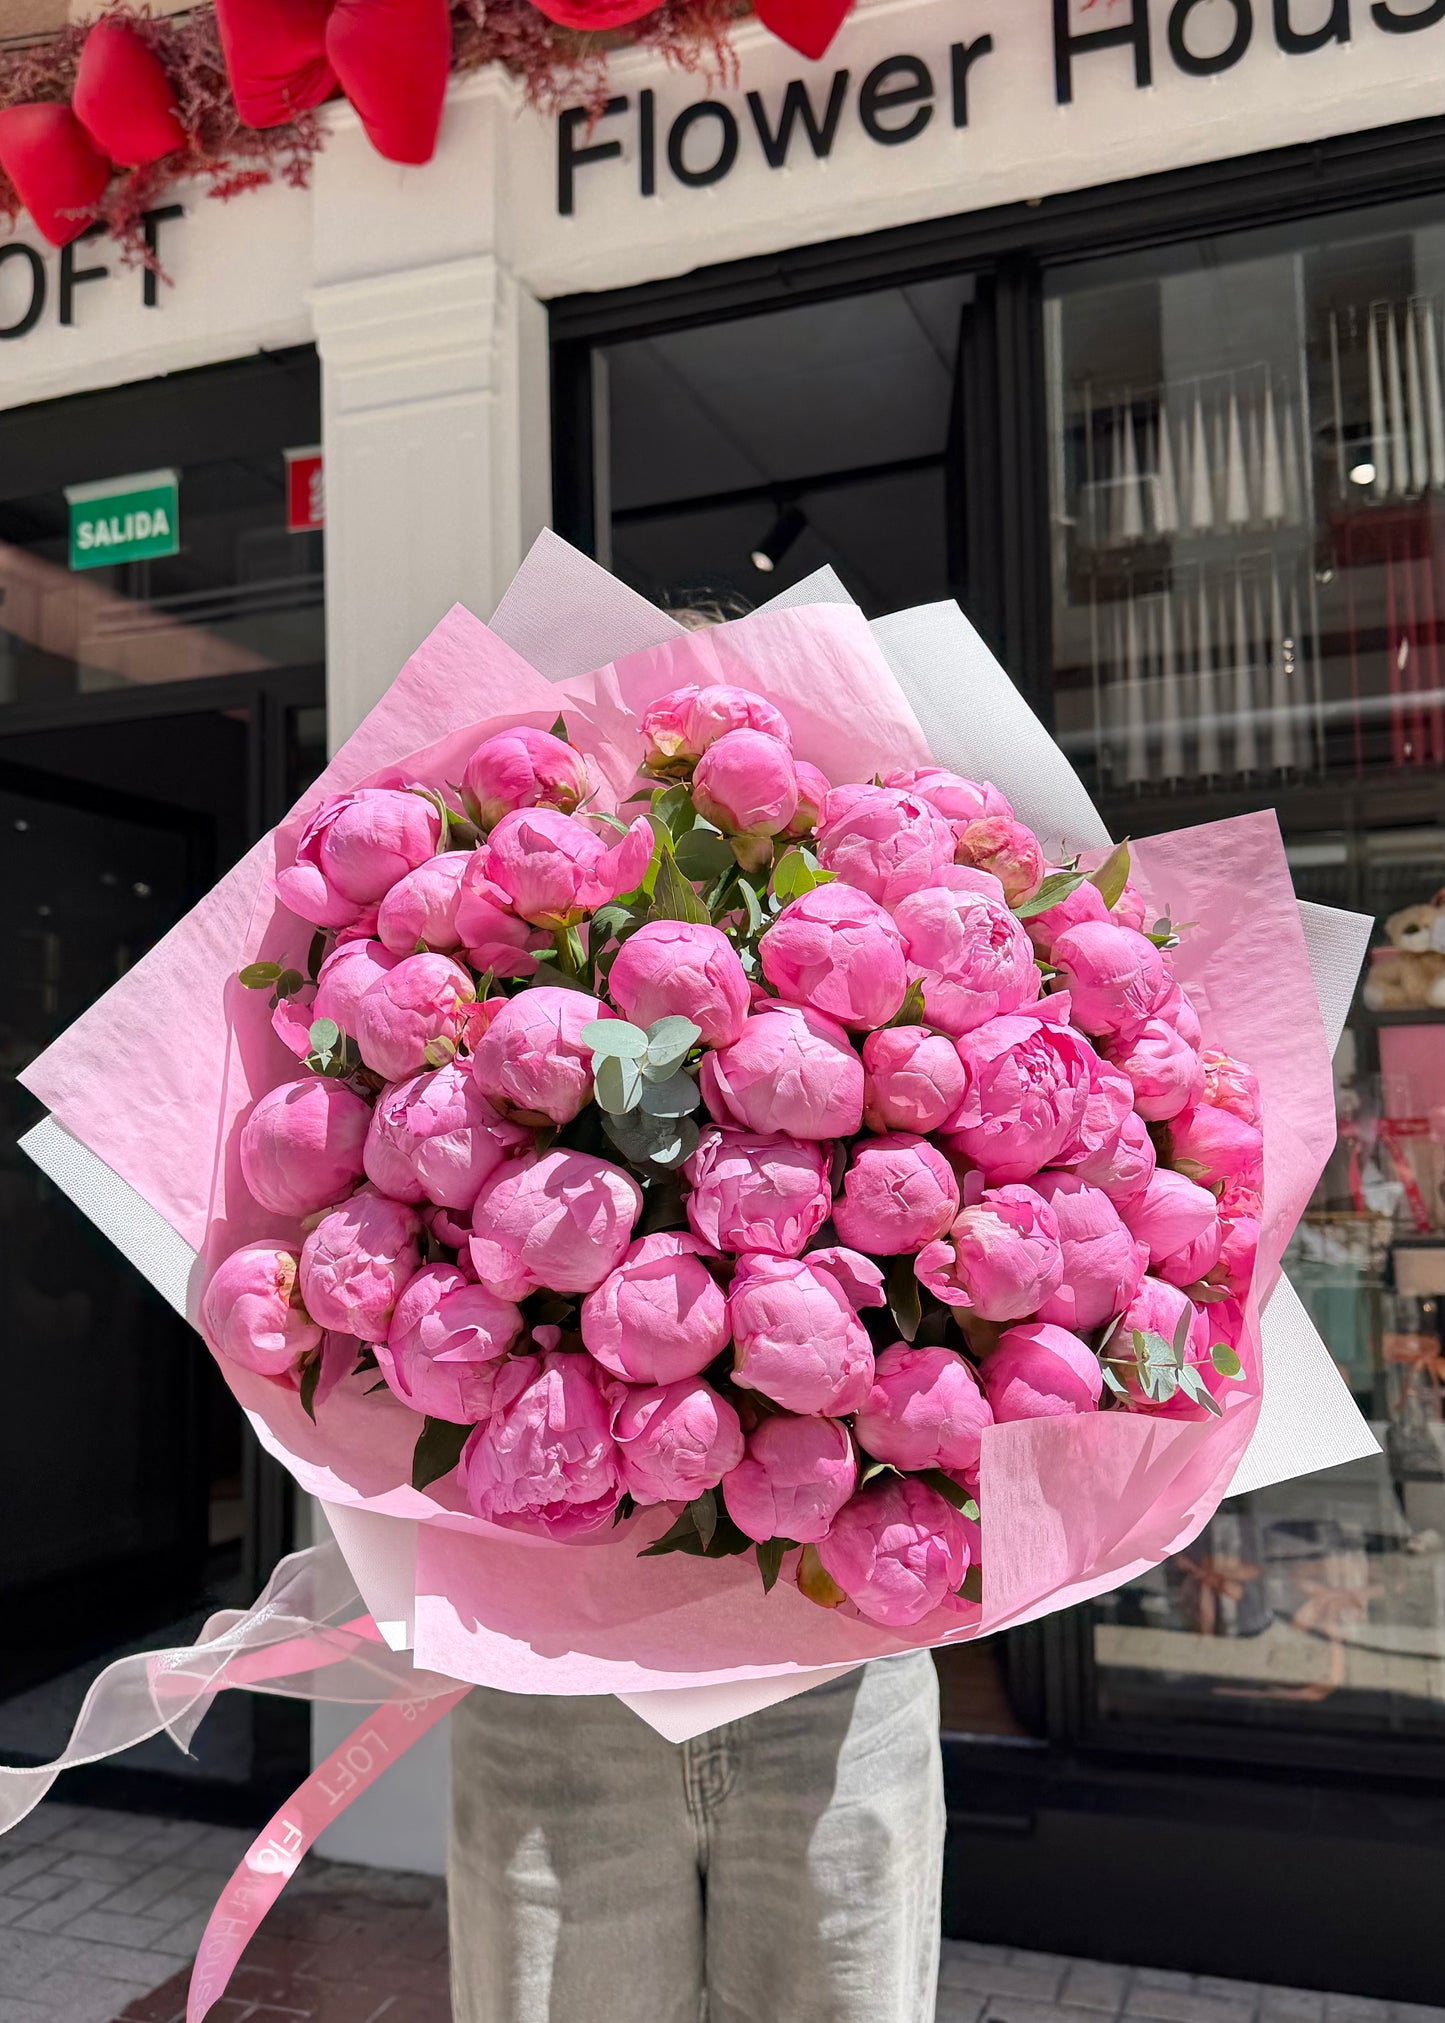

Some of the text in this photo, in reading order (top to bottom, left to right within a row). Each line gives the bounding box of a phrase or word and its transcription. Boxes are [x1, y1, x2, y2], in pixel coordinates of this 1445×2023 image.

[557, 33, 993, 216] Flower
[77, 507, 170, 550] SALIDA
[317, 1729, 388, 1806] LOFT
